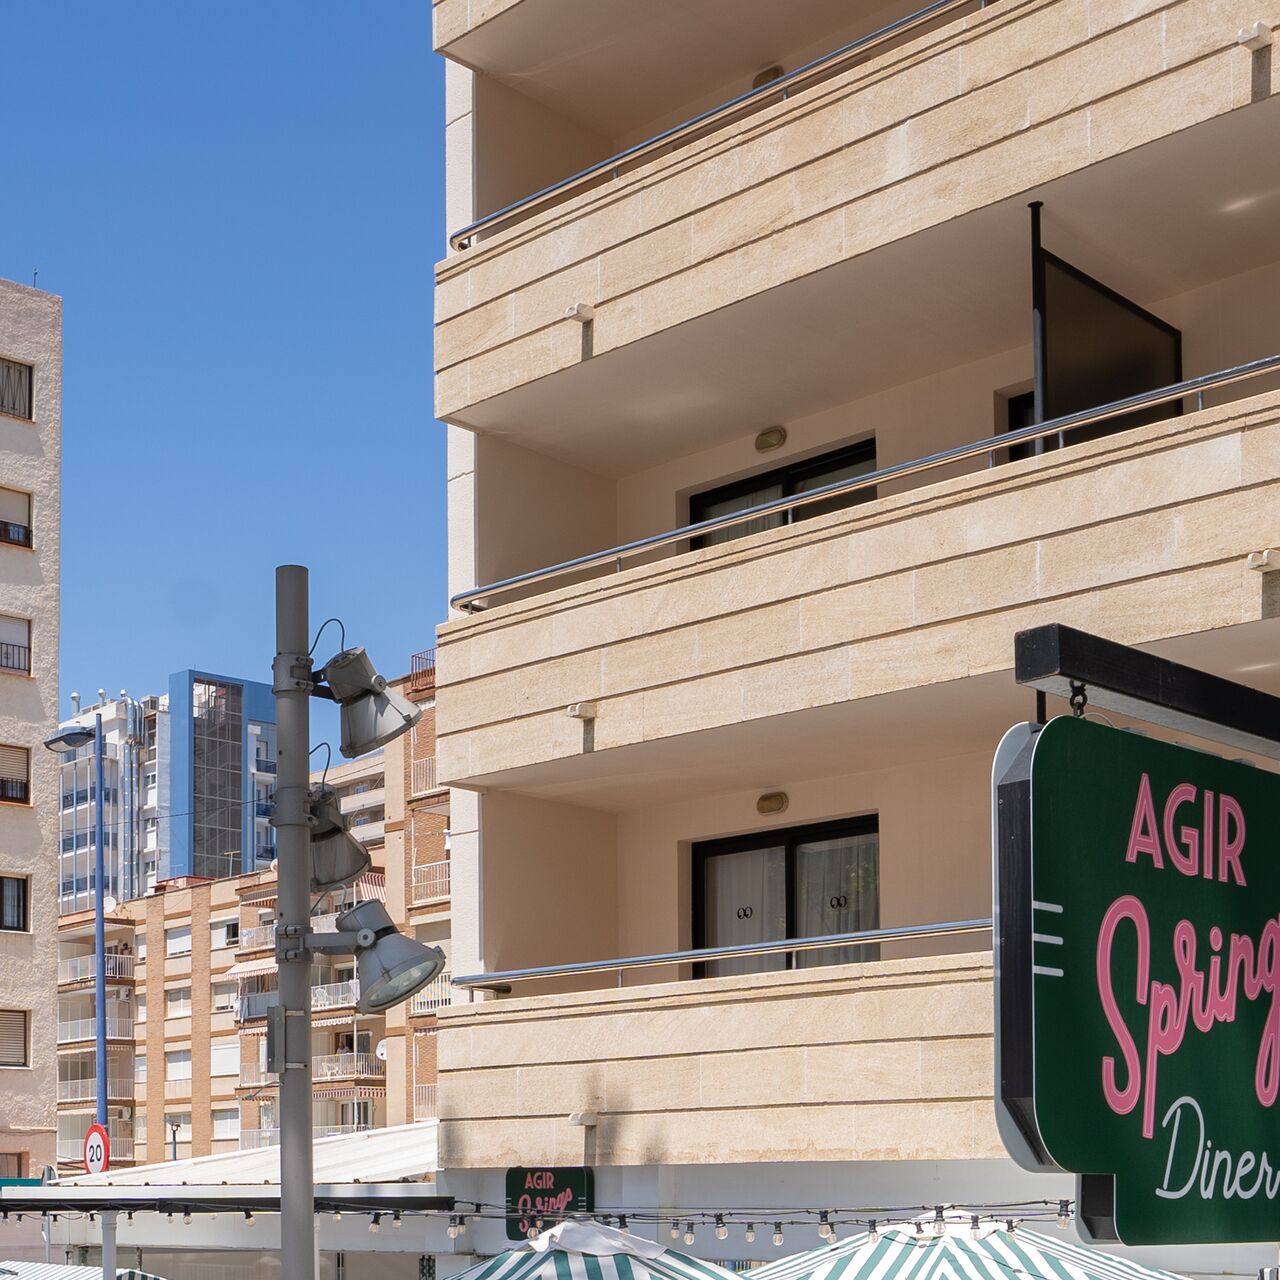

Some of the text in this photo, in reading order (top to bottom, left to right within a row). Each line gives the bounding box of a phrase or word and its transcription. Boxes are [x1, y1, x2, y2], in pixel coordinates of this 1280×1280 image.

[1125, 773, 1247, 887] AGIR
[89, 1144, 102, 1162] 20
[524, 1172, 555, 1189] AGIR
